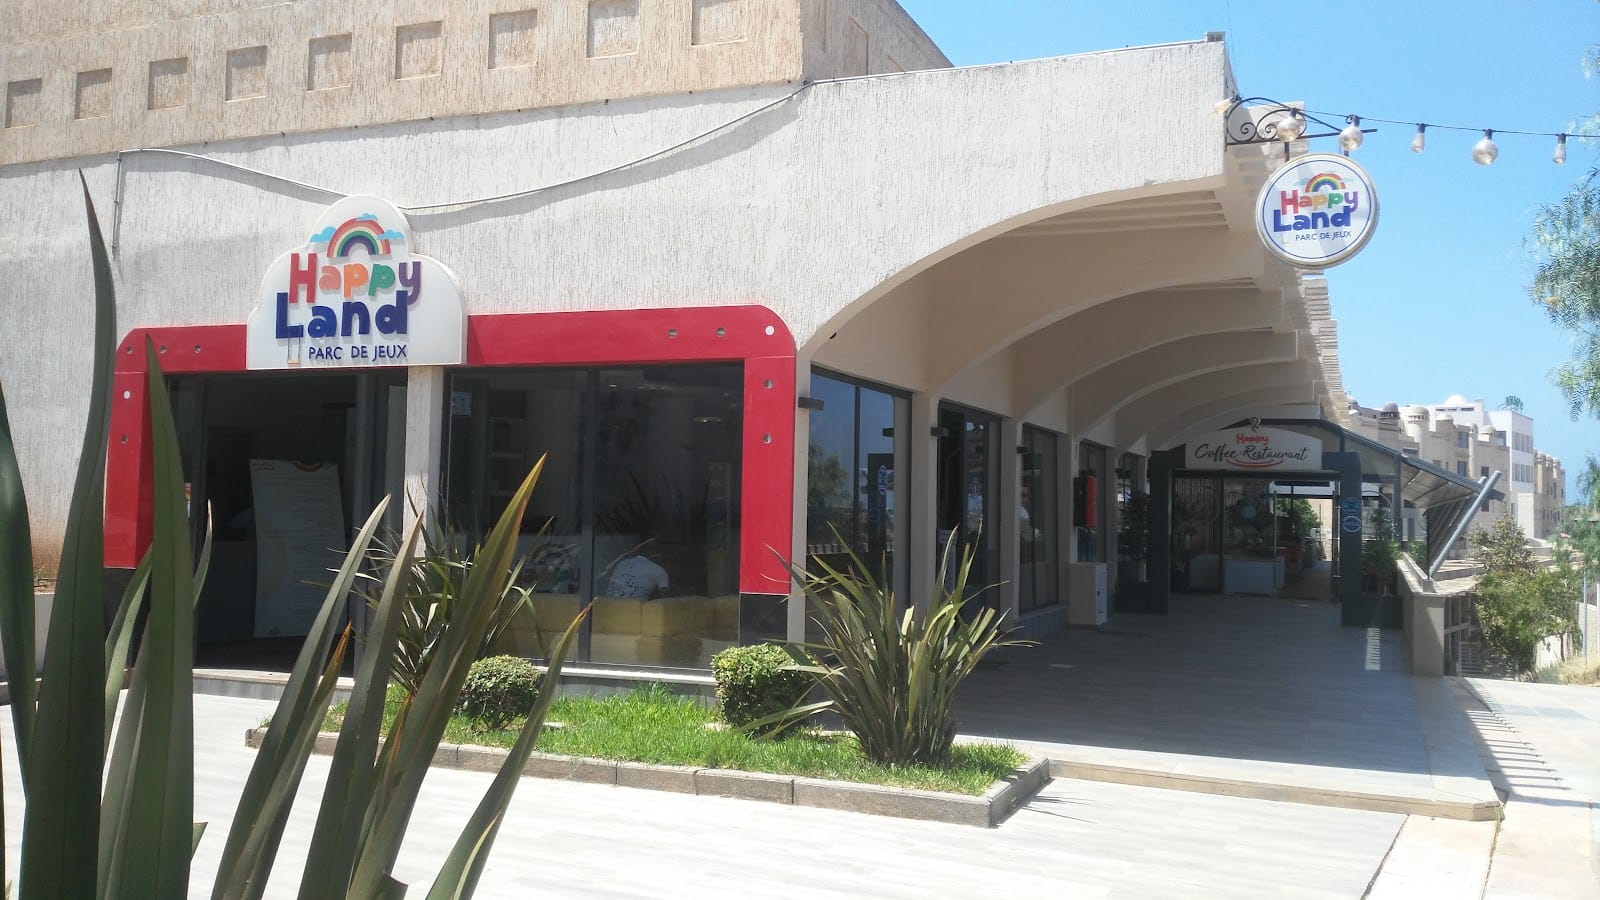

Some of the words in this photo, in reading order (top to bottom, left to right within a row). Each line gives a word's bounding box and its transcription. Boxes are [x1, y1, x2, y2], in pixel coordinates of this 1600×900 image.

[1281, 190, 1358, 215] Happy
[1273, 205, 1351, 232] Land
[1296, 233, 1318, 241] PARC
[1320, 232, 1331, 240] DE
[1332, 231, 1352, 240] JEUX
[288, 253, 421, 306] Happy
[275, 290, 408, 339] Land
[308, 346, 343, 360] PARC
[350, 346, 368, 359] DE
[372, 344, 408, 362] JEUX
[1236, 433, 1269, 445] Happy
[1195, 443, 1239, 462] Coffee
[1242, 445, 1308, 460] Restaurant
